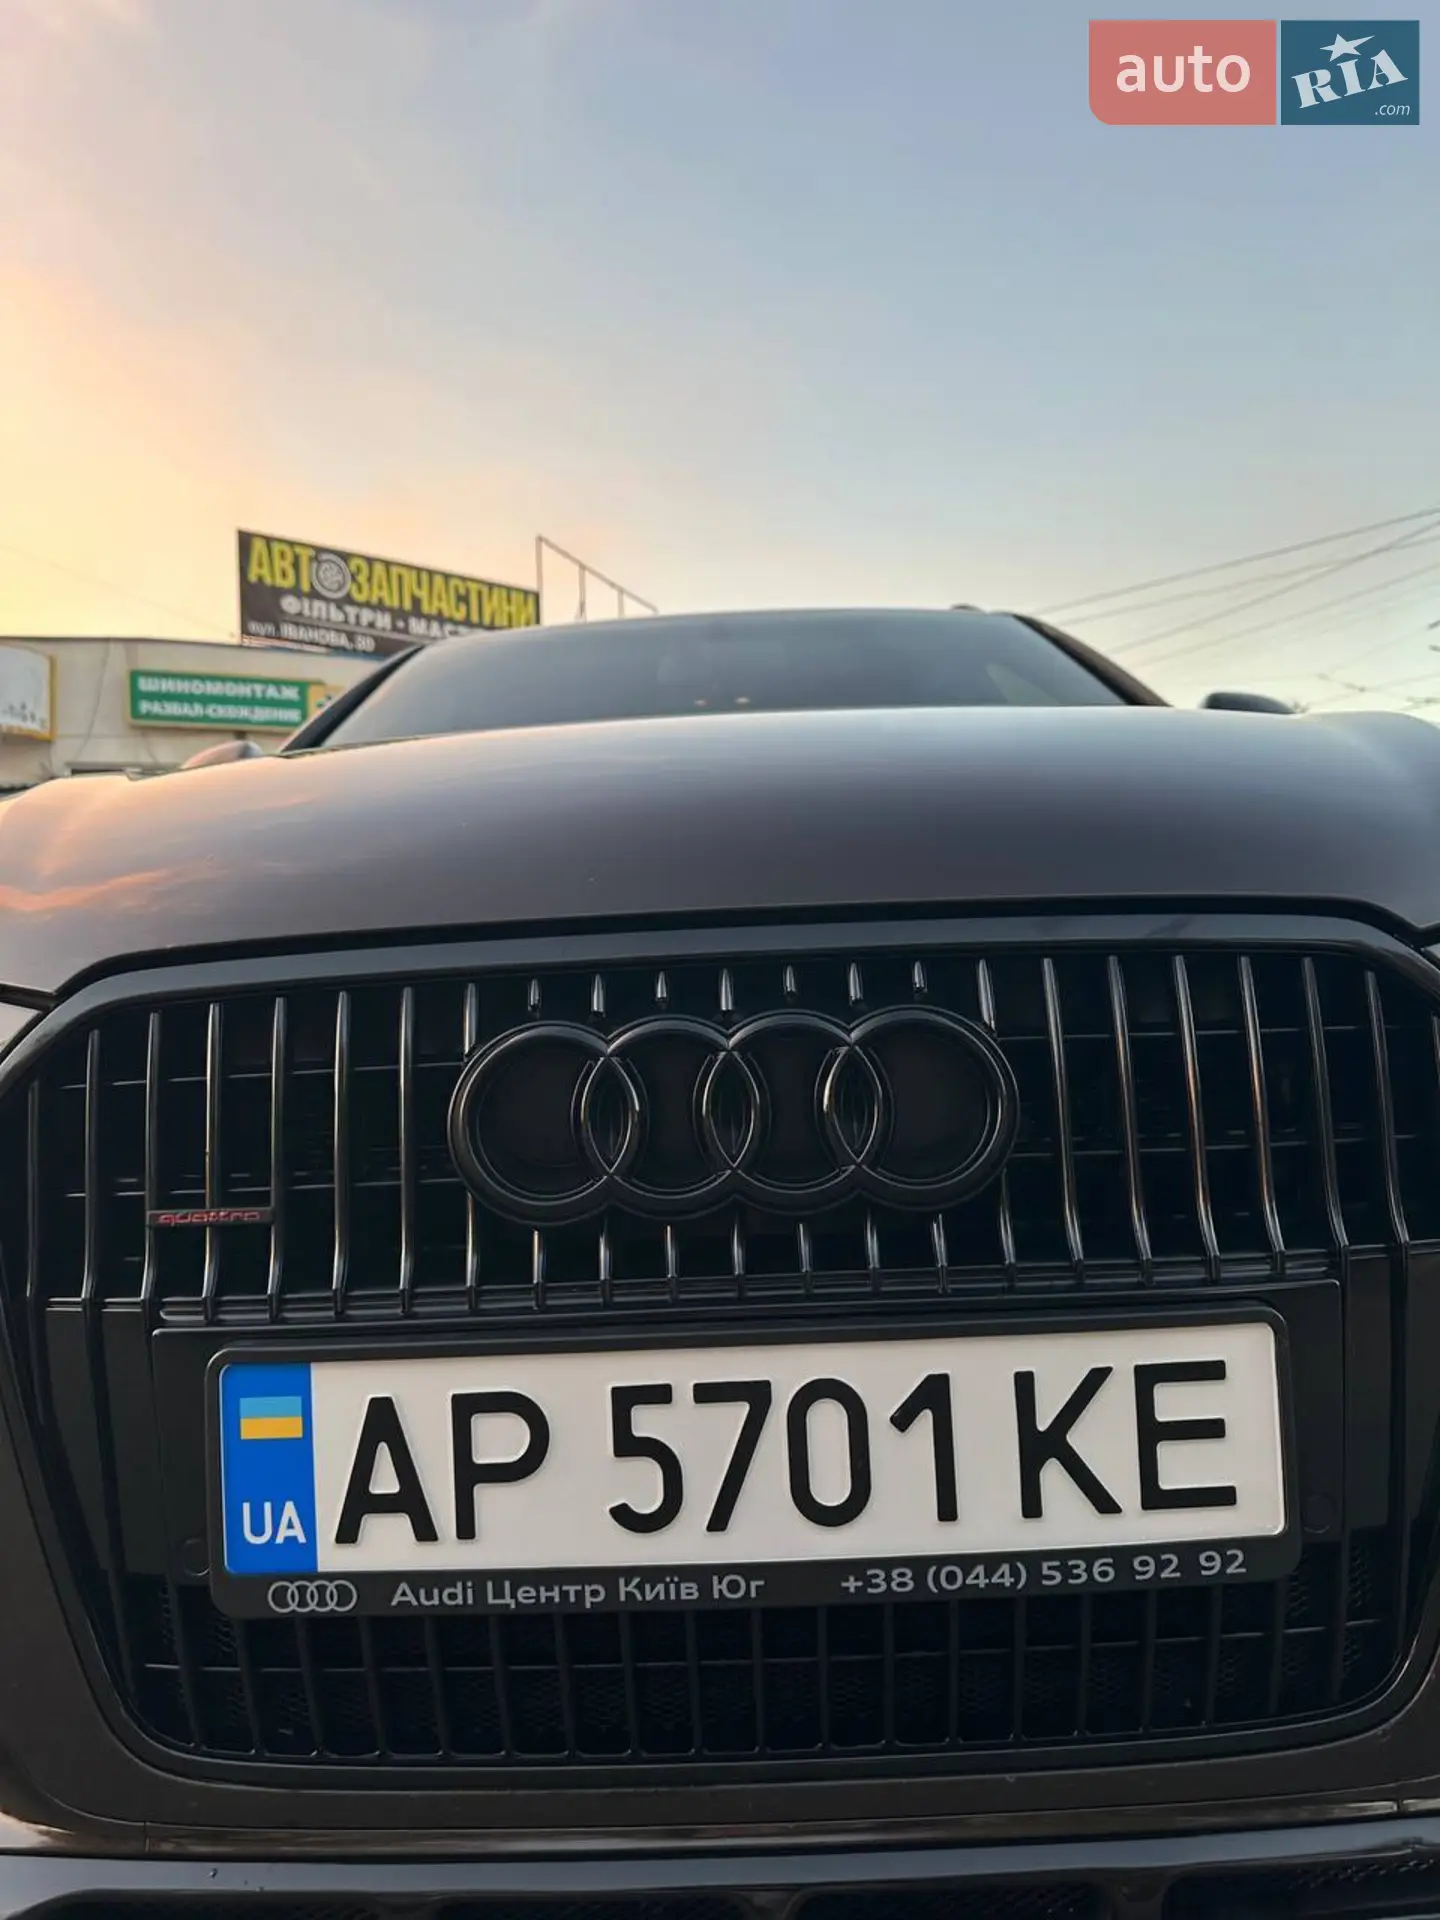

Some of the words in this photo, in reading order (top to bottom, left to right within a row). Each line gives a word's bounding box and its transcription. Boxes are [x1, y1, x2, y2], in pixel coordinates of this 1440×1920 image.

[138, 676, 300, 700] ШИНОМОНТАЖ
[158, 1210, 260, 1226] quattro
[334, 1389, 550, 1544] AP
[608, 1372, 958, 1534] 5701
[1013, 1359, 1237, 1519] KE
[242, 1501, 306, 1545] UA
[840, 1568, 914, 1594] +38
[926, 1560, 1028, 1594] (044)
[1040, 1557, 1116, 1586] 536
[1132, 1553, 1182, 1580] 92
[1199, 1549, 1248, 1576] 92
[391, 1581, 474, 1607] Audi
[486, 1580, 606, 1611] Центр
[618, 1575, 699, 1602] Київ
[712, 1574, 765, 1600] Юг
